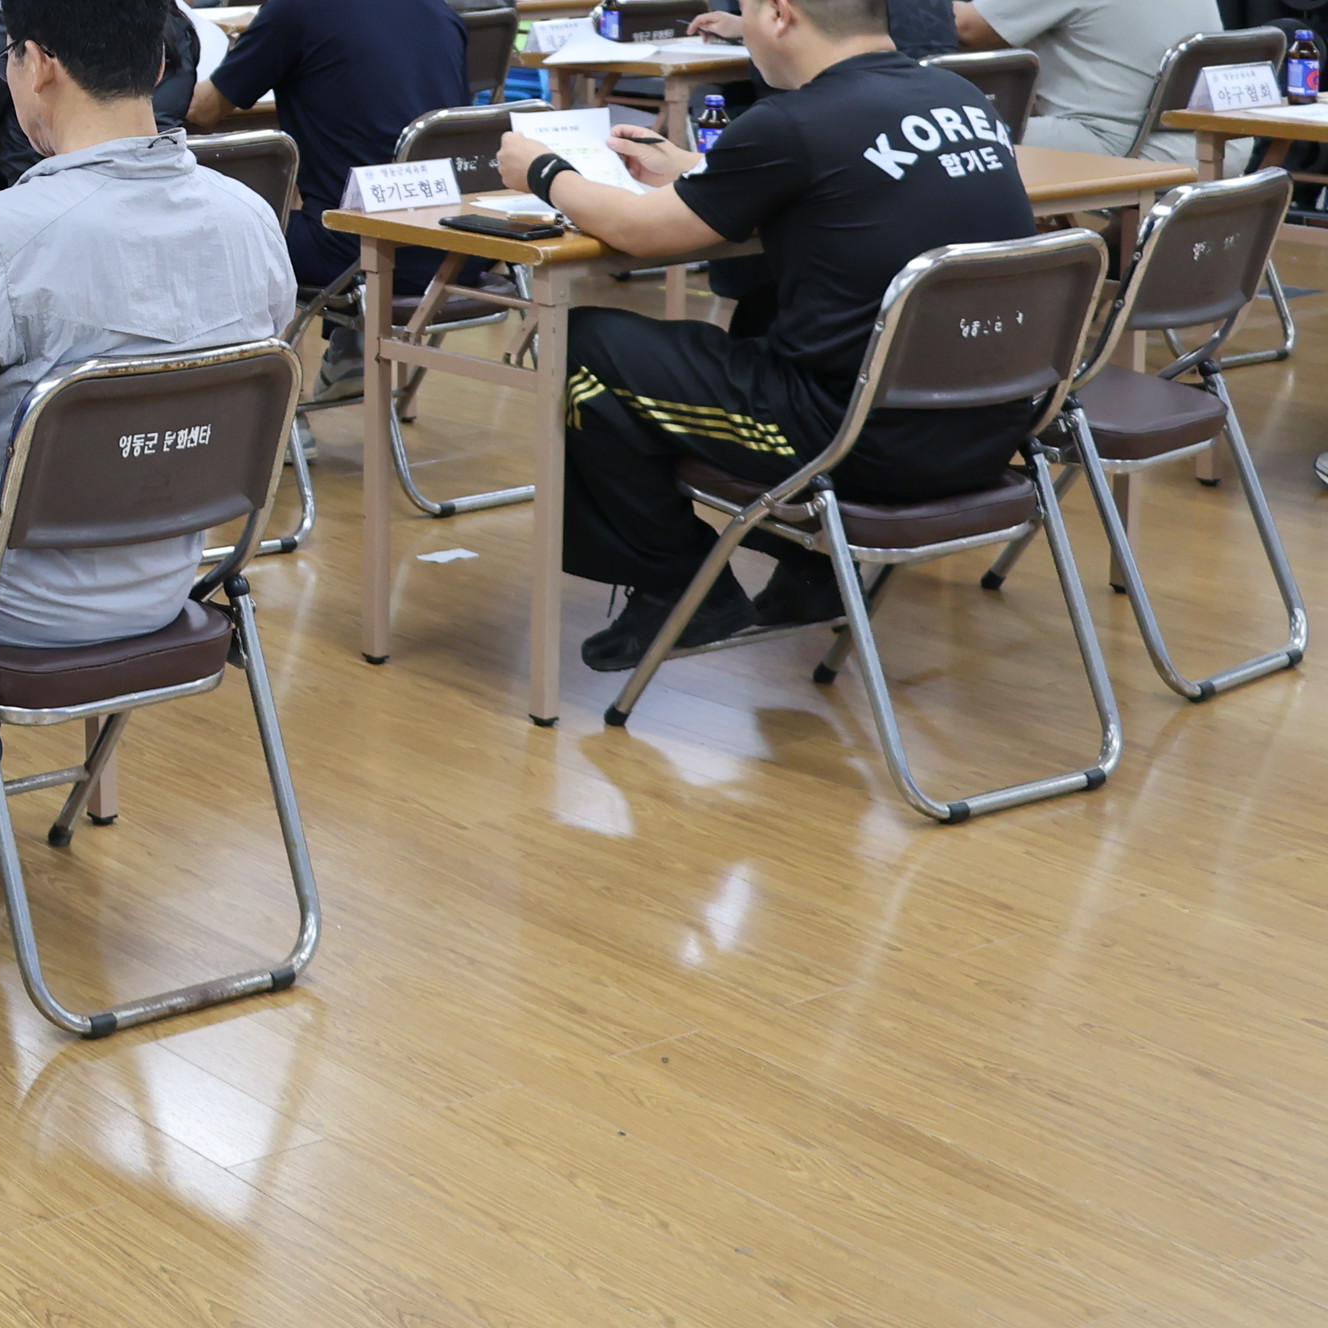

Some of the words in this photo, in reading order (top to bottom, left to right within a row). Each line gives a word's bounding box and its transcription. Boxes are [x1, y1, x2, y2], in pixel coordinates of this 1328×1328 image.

[1217, 82, 1273, 105] 야구협회
[862, 105, 1015, 181] KOREA
[937, 146, 1004, 178] 합기도
[370, 178, 450, 203] 합기도협회
[119, 433, 159, 458] 영동군
